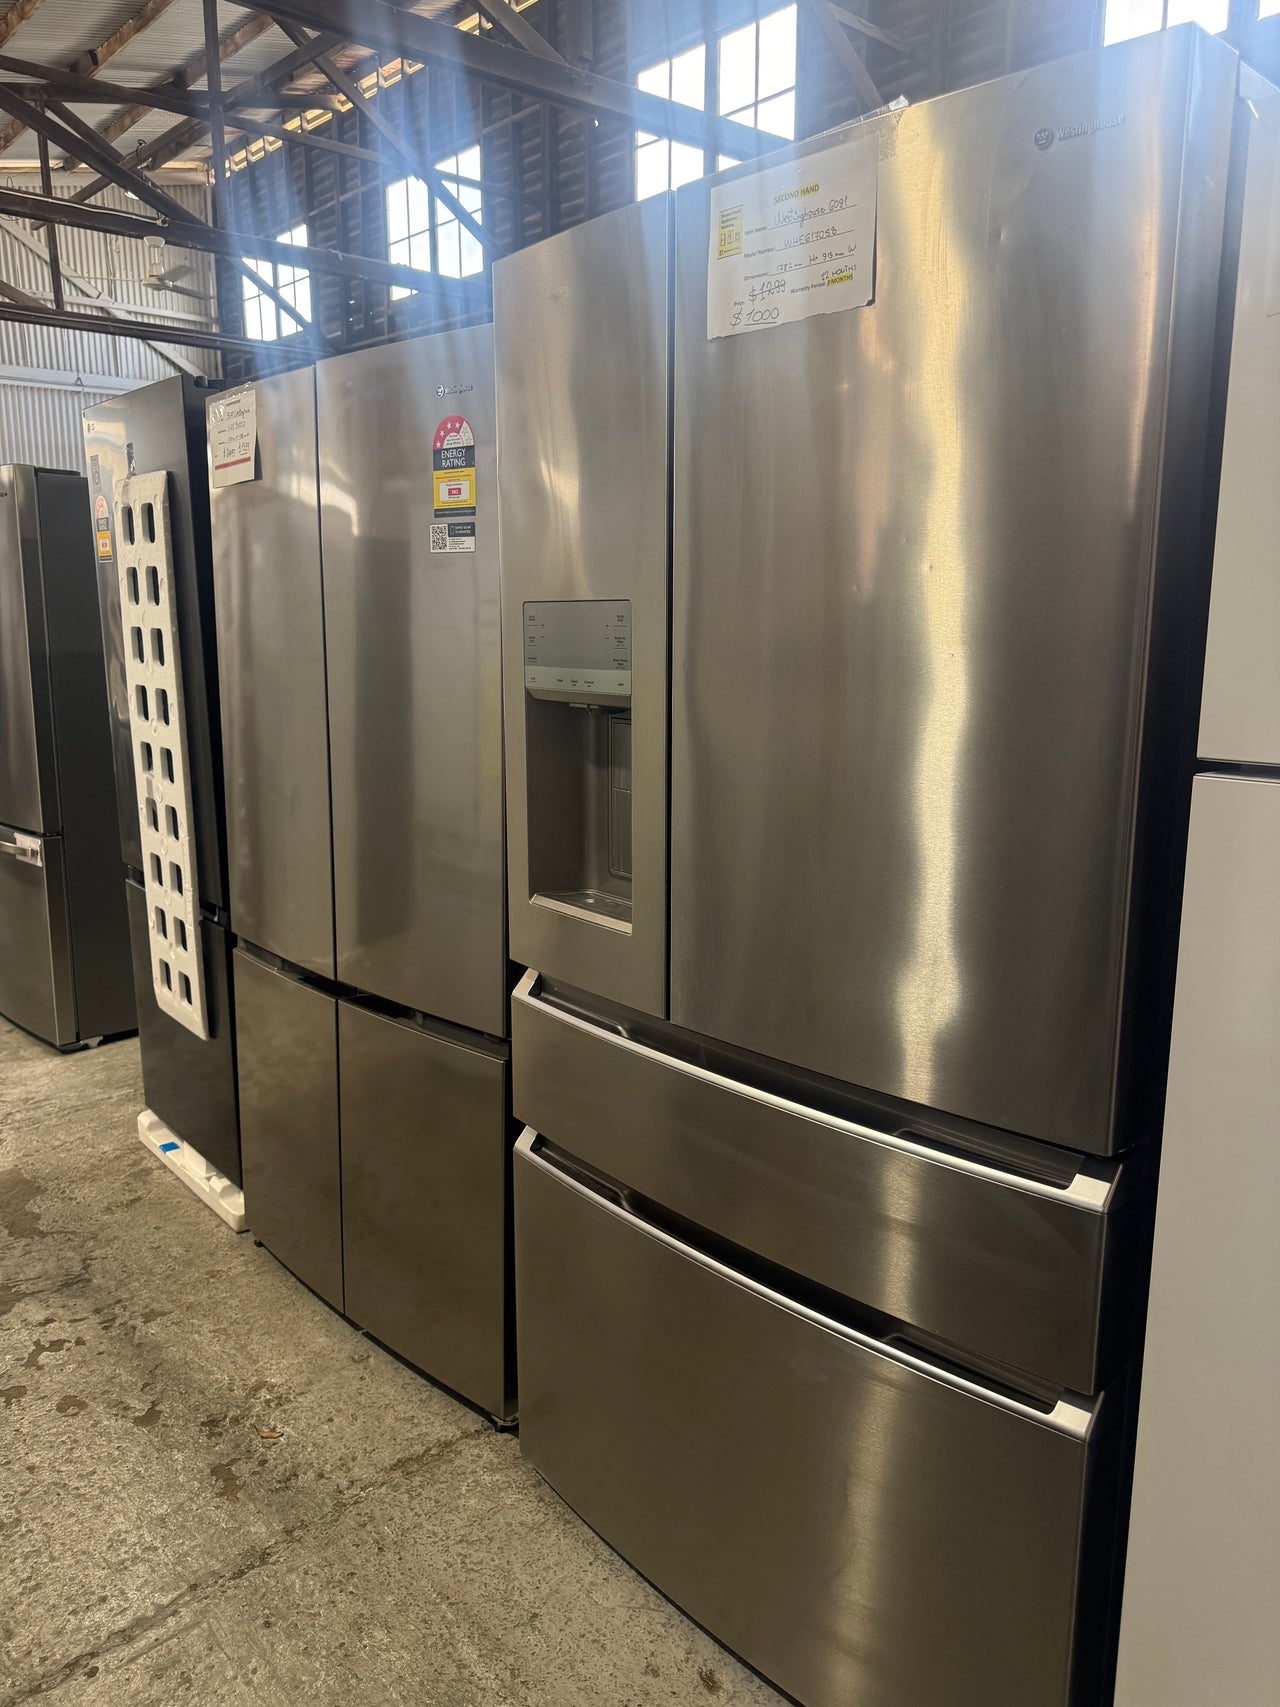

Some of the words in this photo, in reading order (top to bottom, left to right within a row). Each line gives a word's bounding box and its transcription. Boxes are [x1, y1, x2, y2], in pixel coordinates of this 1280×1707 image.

[774, 190, 799, 204] SECOND
[800, 184, 819, 196] HAND
[831, 264, 857, 277] MONTHS
[790, 285, 811, 295] Warranty
[830, 273, 854, 285] MONTHS
[441, 448, 466, 459] ENERGY
[442, 458, 466, 468] RATING
